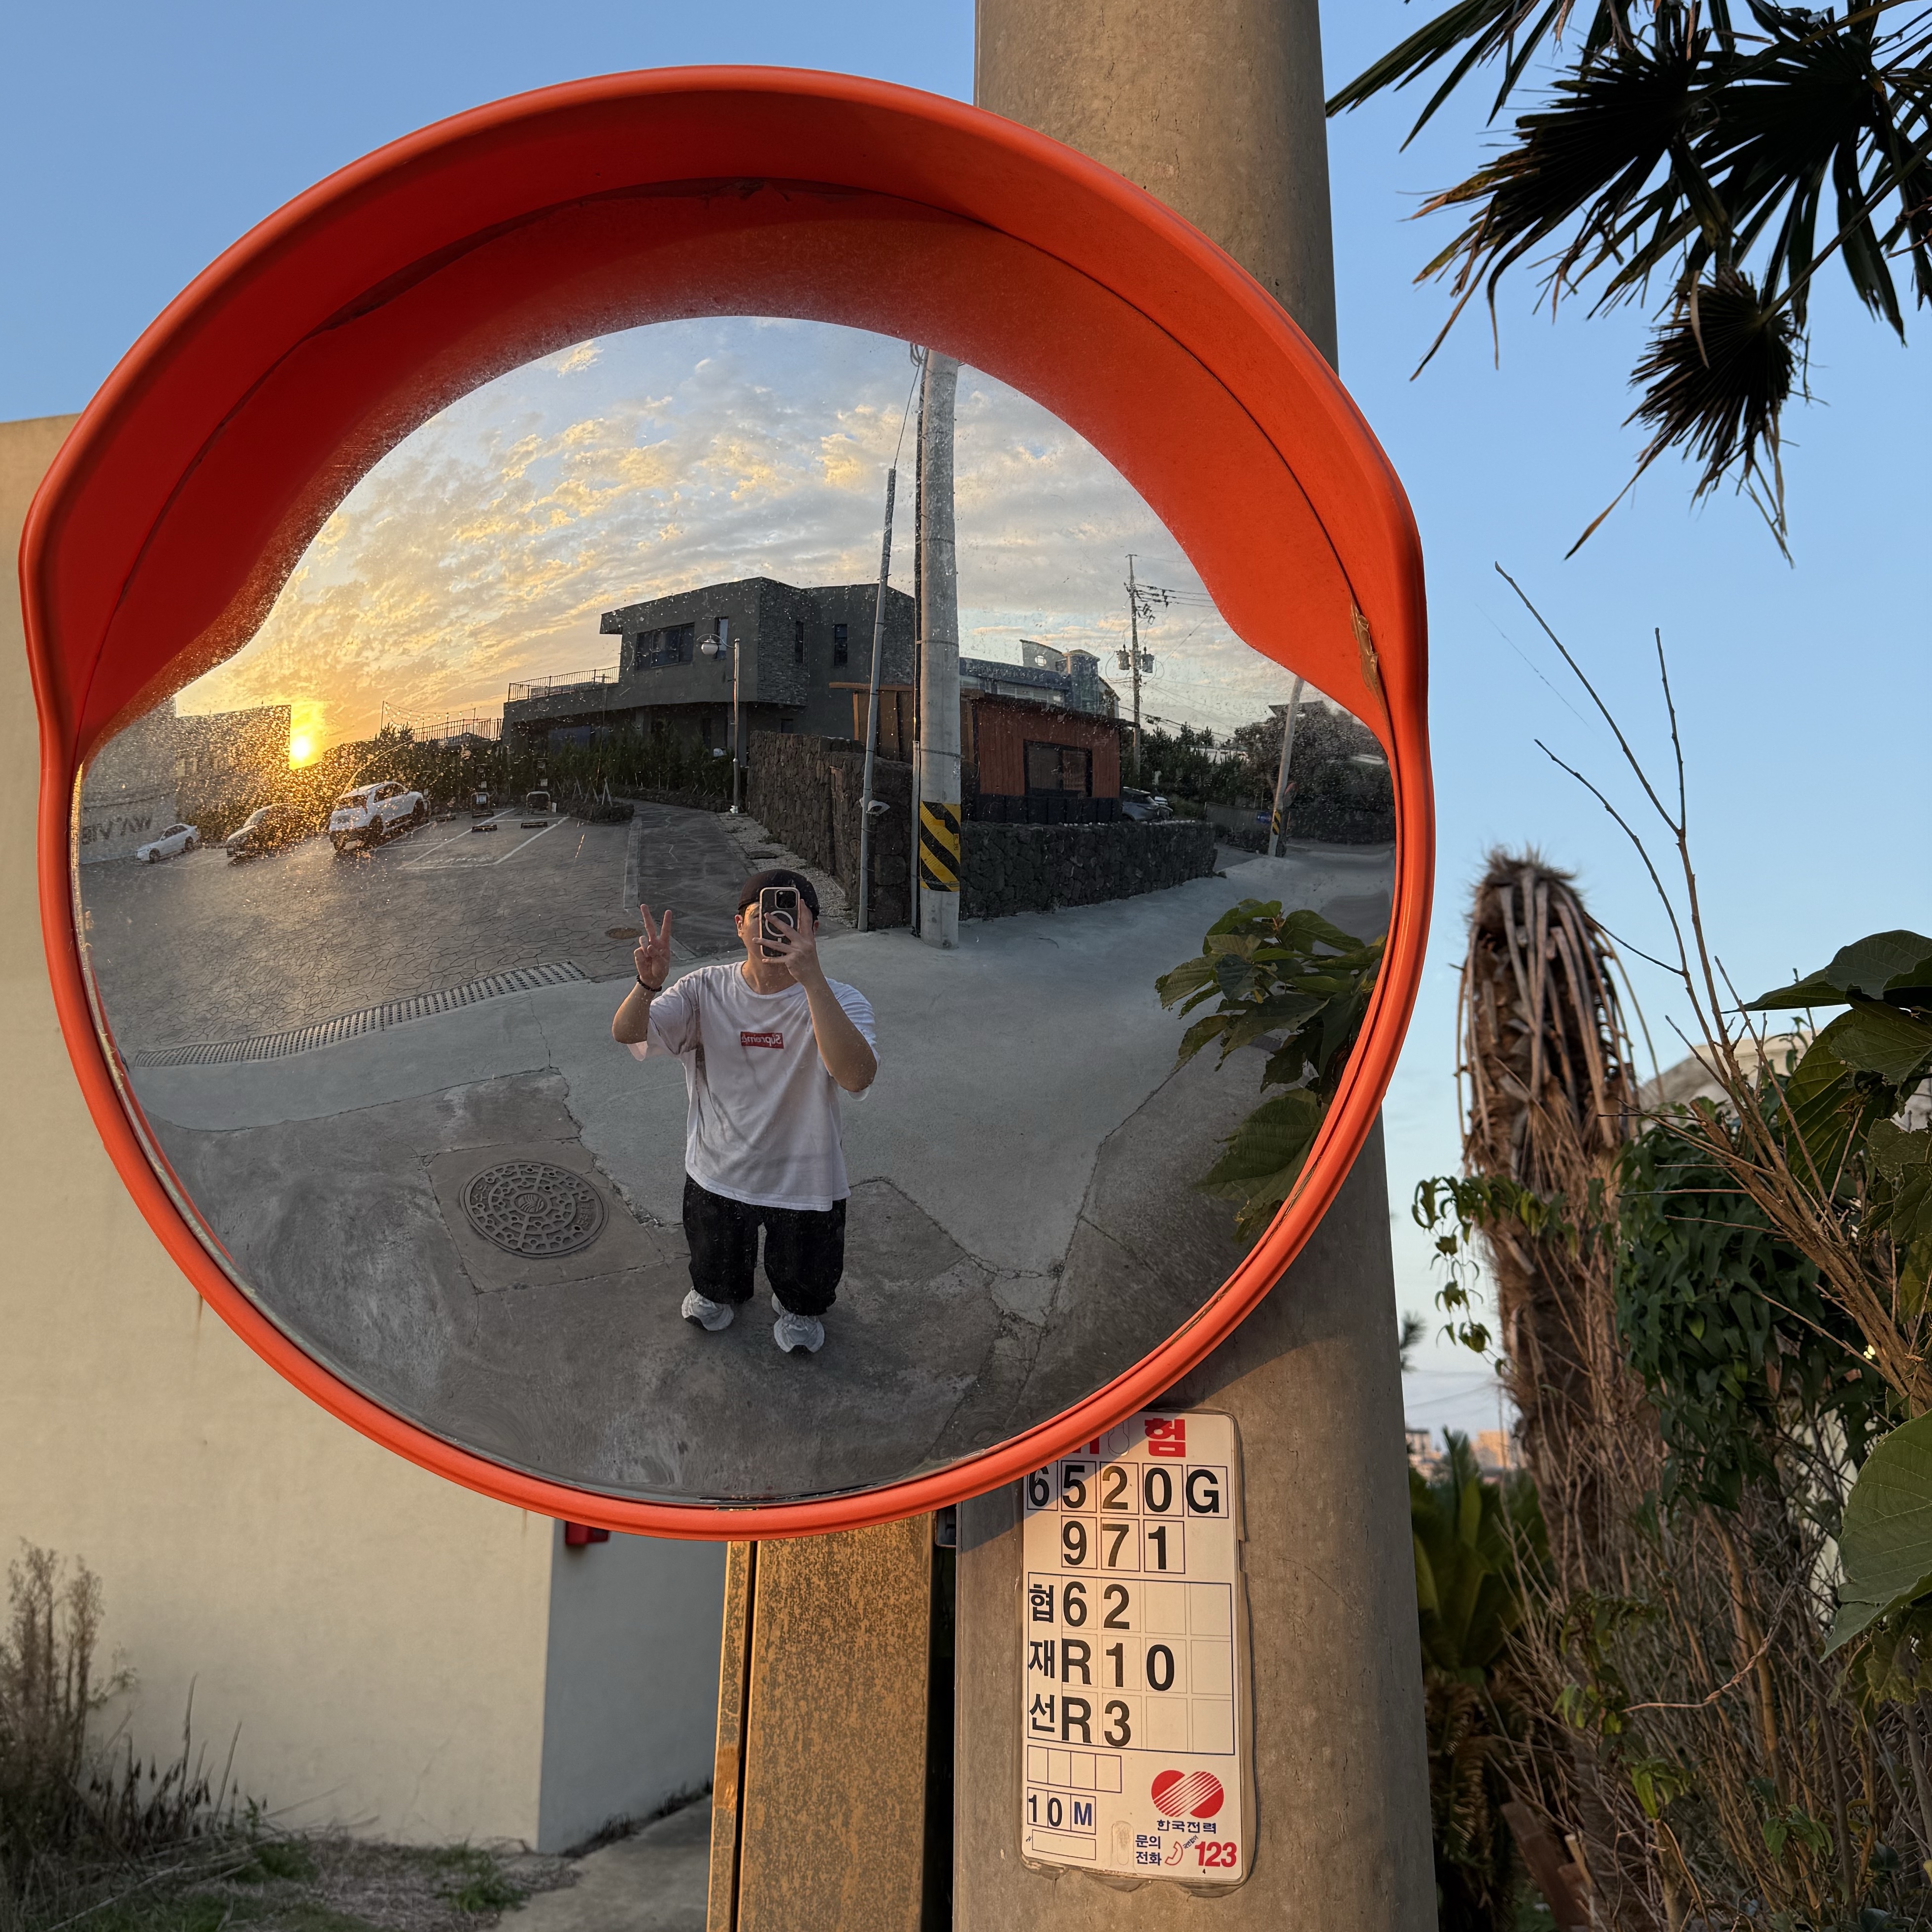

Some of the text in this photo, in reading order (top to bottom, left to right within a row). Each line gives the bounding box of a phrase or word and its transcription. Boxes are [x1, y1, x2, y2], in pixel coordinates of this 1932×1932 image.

[1028, 1465, 1220, 1514] 6520G
[1063, 1521, 1167, 1570] 971
[1156, 1819, 1217, 1834] 한국전력
[1135, 1834, 1161, 1849] 문의
[1135, 1851, 1162, 1866] 전화
[1194, 1841, 1237, 1868] 123
